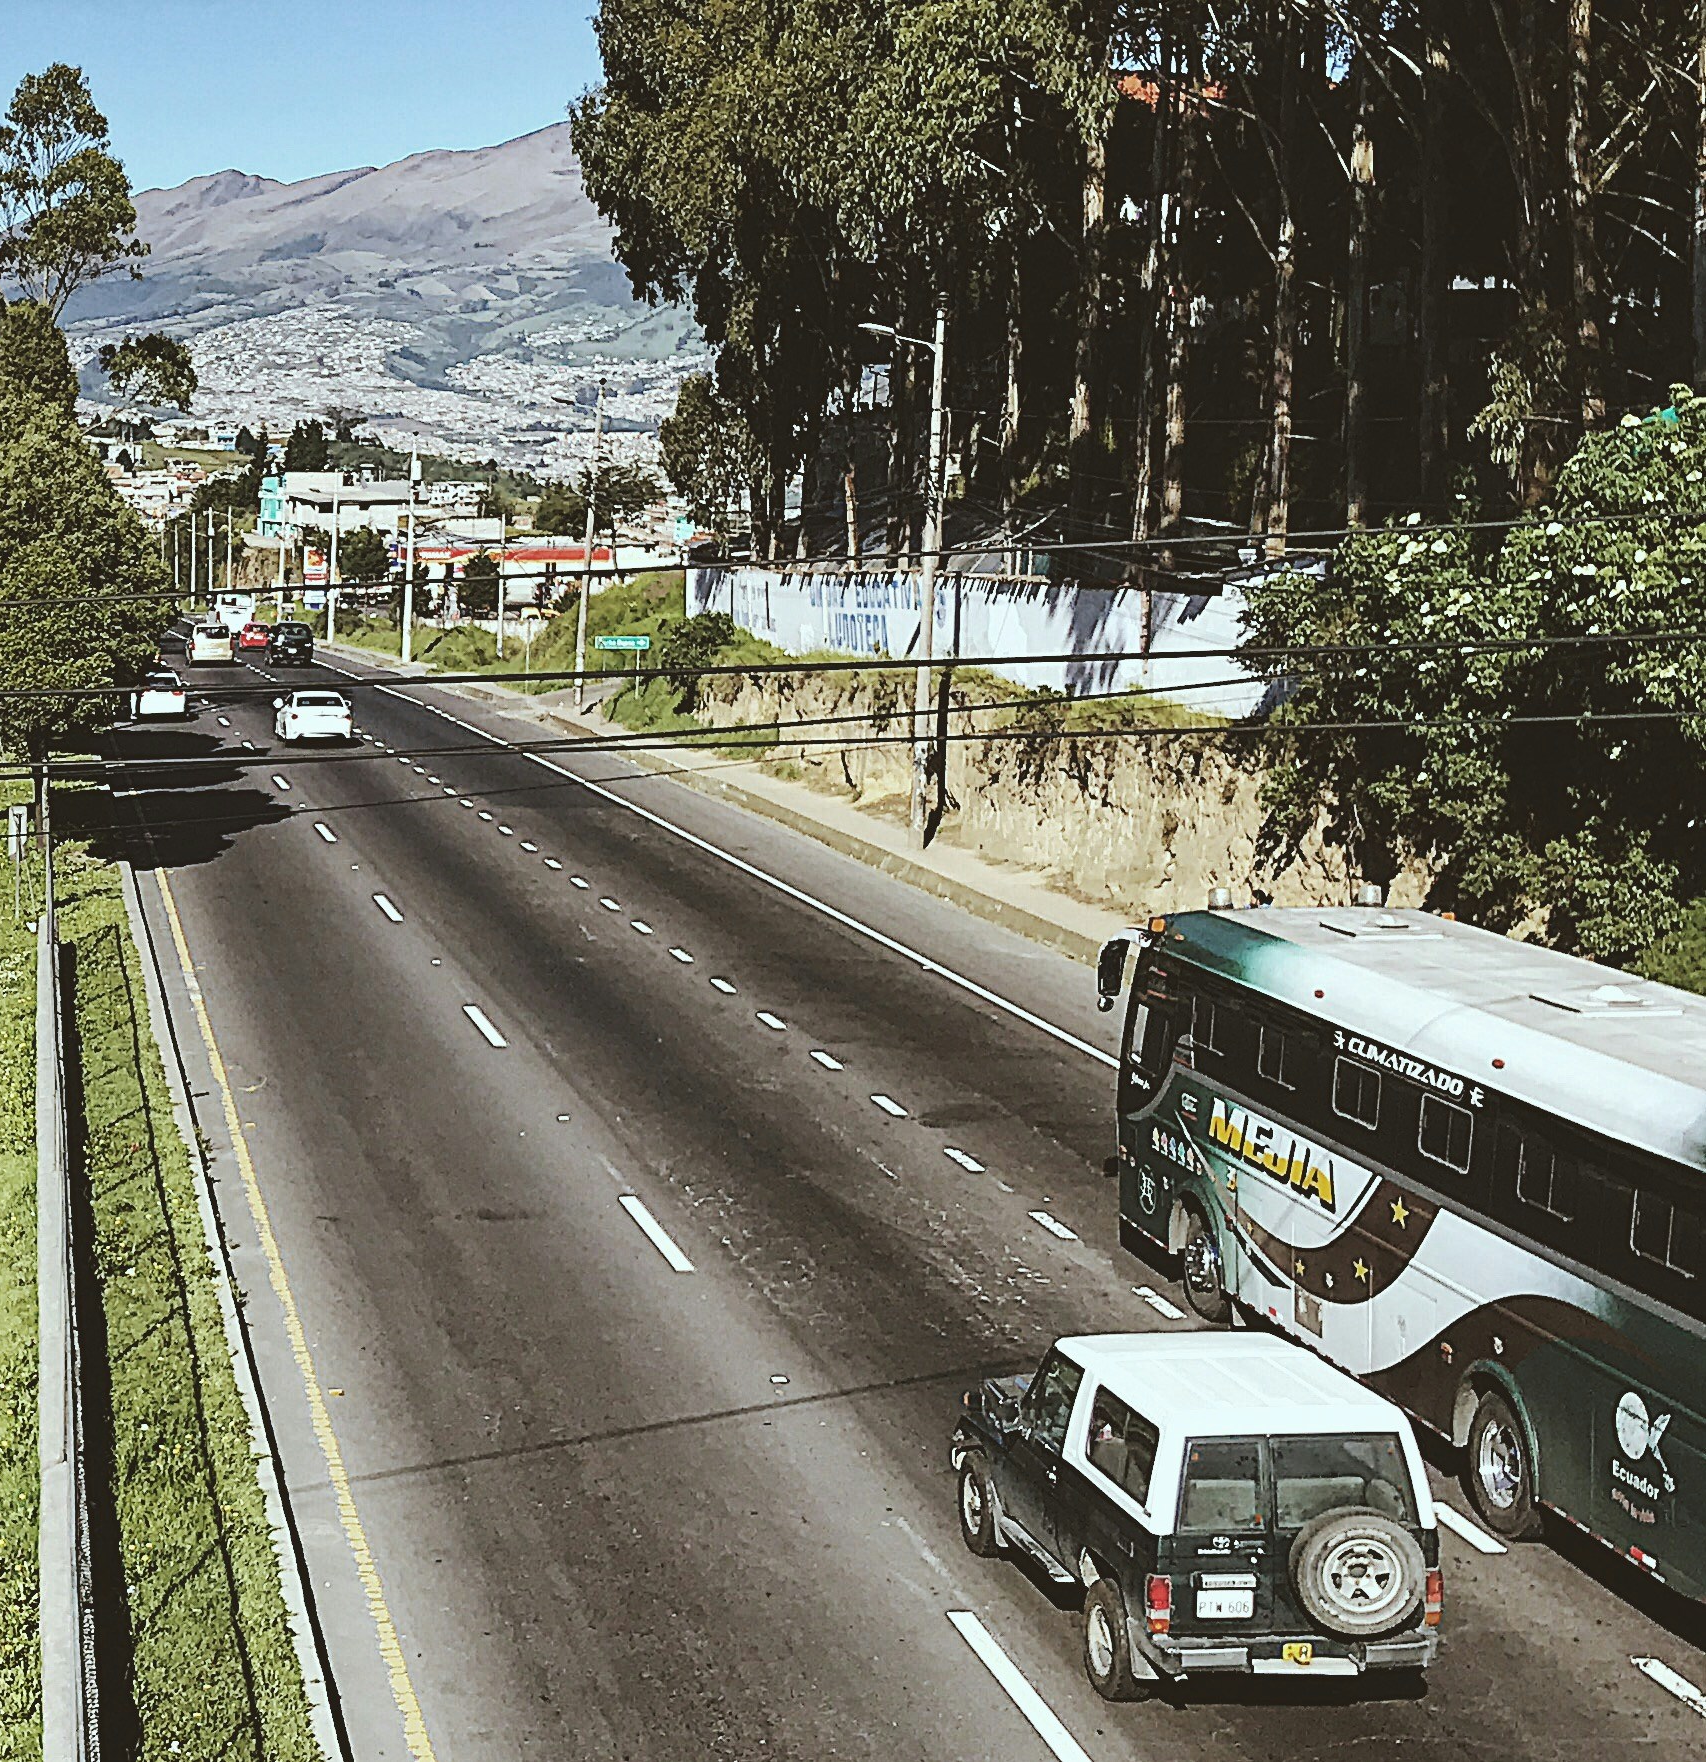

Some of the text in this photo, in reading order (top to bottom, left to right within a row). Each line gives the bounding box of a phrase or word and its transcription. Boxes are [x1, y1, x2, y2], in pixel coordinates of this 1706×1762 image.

[828, 612, 890, 651] LUDOTECA
[1347, 1036, 1465, 1096] CLIMATIZADO
[1208, 1096, 1336, 1212] MEJIA
[1612, 1458, 1660, 1501] Ecuador
